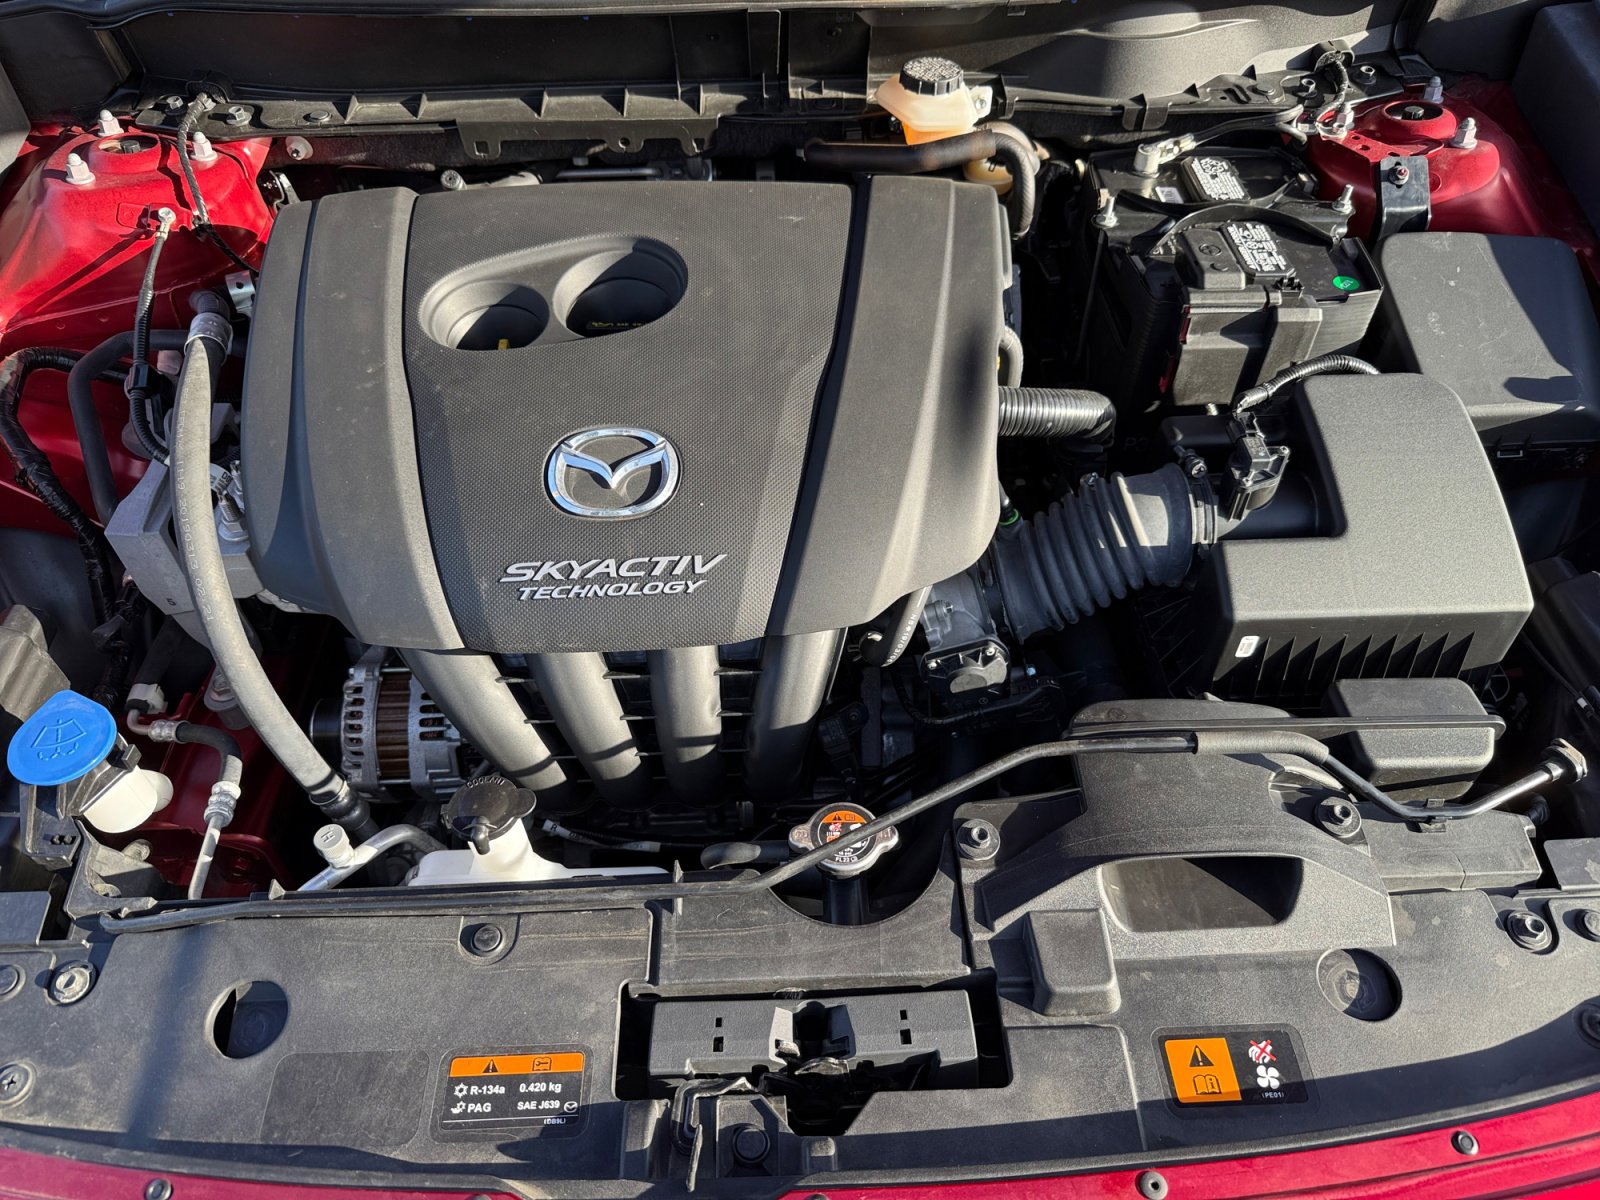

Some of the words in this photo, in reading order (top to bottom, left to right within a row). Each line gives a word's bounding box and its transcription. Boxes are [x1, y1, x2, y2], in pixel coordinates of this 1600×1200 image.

[498, 554, 728, 583] SKYACTIV
[517, 579, 708, 600] TECHNOLOGY
[470, 1084, 505, 1096] R-134a
[519, 1083, 546, 1093] 0.420
[548, 1082, 562, 1094] kg
[467, 1102, 492, 1114] PAG
[517, 1101, 537, 1111] SAE
[539, 1100, 560, 1110] J639
